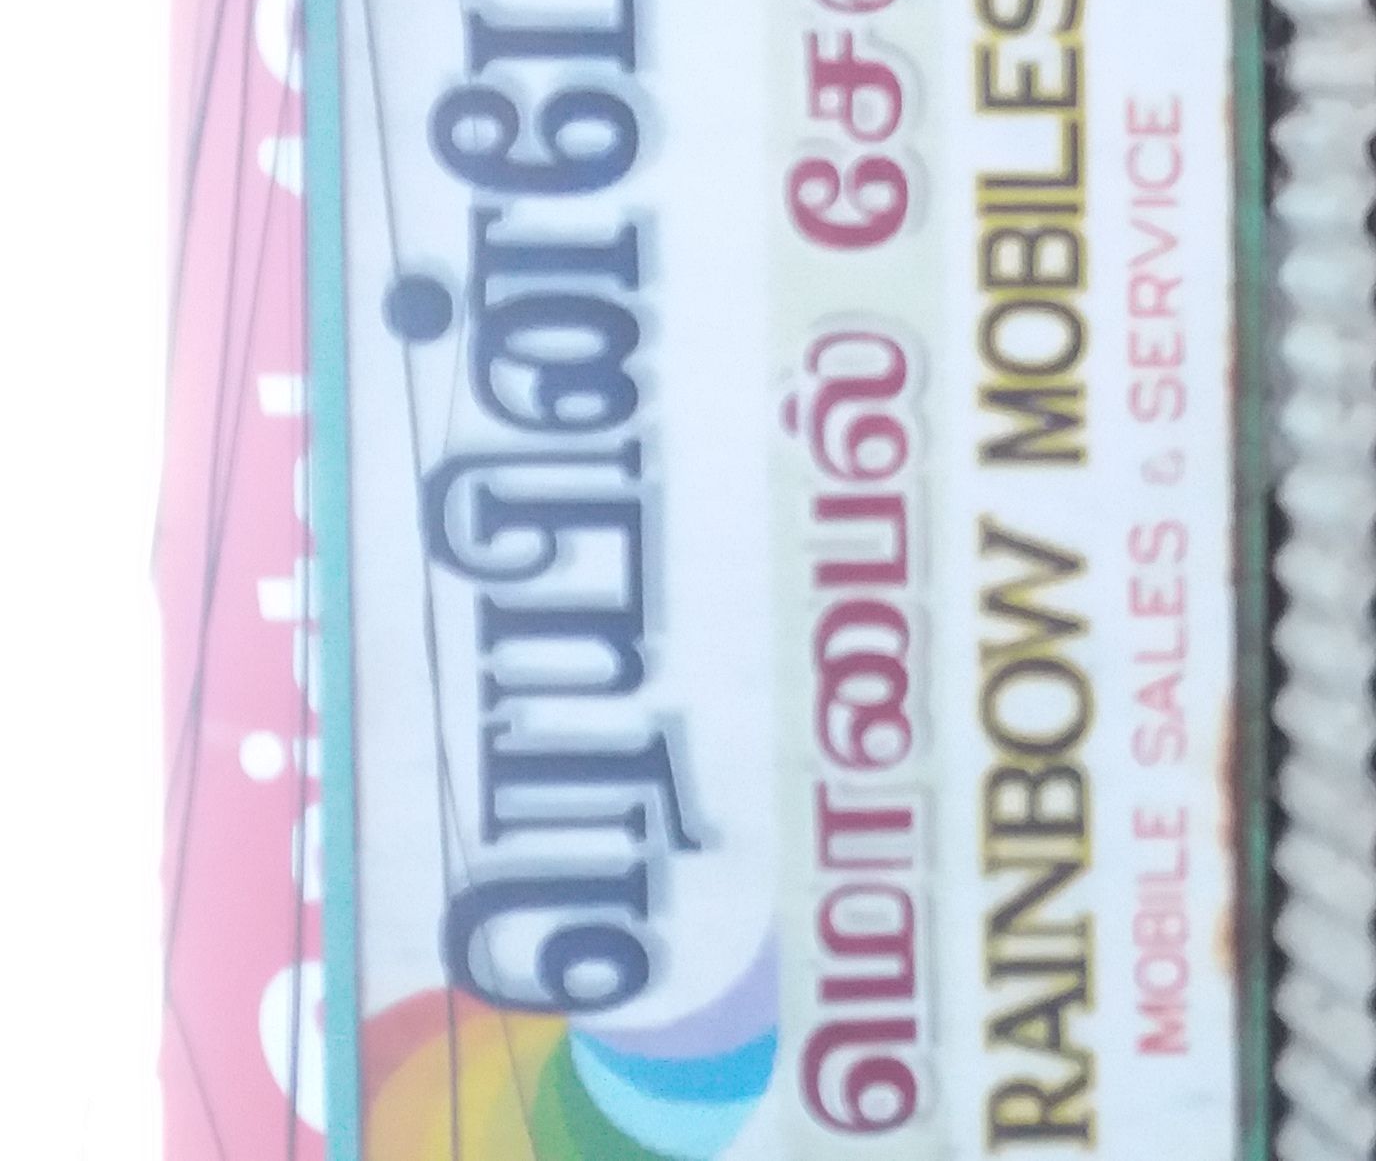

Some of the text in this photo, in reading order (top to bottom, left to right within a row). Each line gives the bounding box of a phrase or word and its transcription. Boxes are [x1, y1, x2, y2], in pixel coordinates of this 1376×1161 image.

[1124, 93, 1186, 423] SERVICE
[782, 329, 919, 1133] மொபைல்
[1126, 518, 1190, 763] SALES
[976, 513, 1097, 1153] RAINBOW
[1131, 807, 1192, 1058] MOBILE
